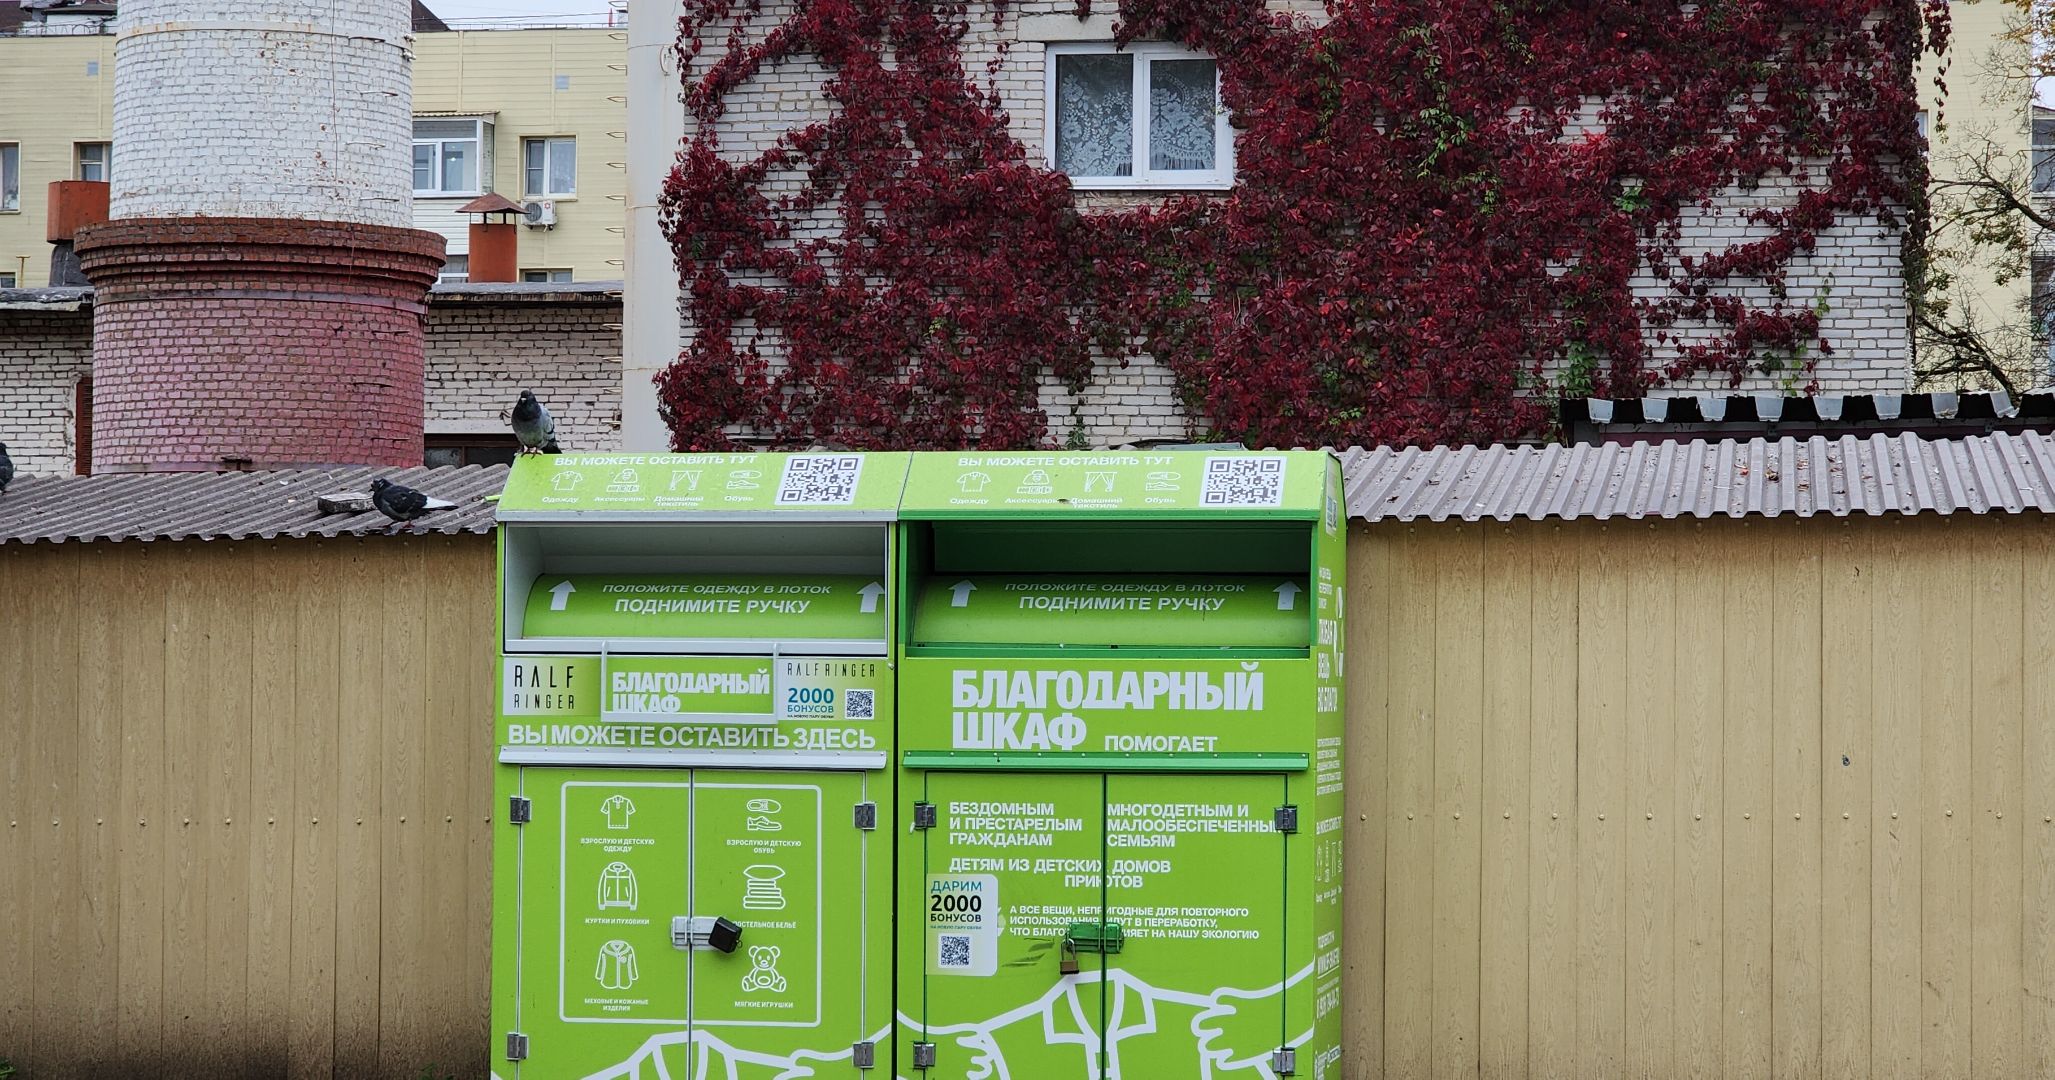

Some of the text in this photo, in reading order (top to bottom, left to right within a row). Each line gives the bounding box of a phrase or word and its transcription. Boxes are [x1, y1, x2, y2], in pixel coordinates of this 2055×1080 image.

[554, 455, 757, 467] ВЫ МОЖЕТЕ ОСТАВИТЬ ТУТ
[958, 456, 1173, 467] ВЫ МОЖЕТЕ ОСТАВИТЬ ТУТ
[542, 496, 579, 504] Одежду
[950, 497, 989, 505] Одежду
[1145, 496, 1176, 504] Обувь
[602, 583, 832, 594] ПОЛОЖИТЕ ОДЕЖДУ В ЛОТОК
[1004, 583, 1245, 593] ПОЛОЖИТЕ ОДЕЖДУ В ЛОТОК
[614, 599, 810, 615] ПОДНИМИТЕ РУЧКУ
[1019, 596, 1224, 613] ПОДНИМИТЕ РУЧКУ
[514, 665, 575, 688] RALF
[612, 668, 770, 694] БЛАГОДАРНЫЙ
[952, 662, 1264, 711] БЛАГОДАРНЫЙ
[514, 693, 575, 709] RINGER
[788, 688, 834, 704] 2000
[612, 694, 681, 713] ШКАФ
[788, 704, 834, 714] БОНУСОВ
[508, 725, 875, 749] ВЫ МОЖЕТЕ ОСТАВИТЬ ЗДЕСЬ
[952, 712, 1218, 752] ШКАФ ПОМОГАЕТ
[949, 802, 1054, 816] БЕЗДОМНЫМ
[1107, 804, 1249, 818] МНОГОДЕТНЫМ И
[949, 818, 1082, 831] И ПРЕСТАРЕЛЫМ
[1107, 818, 1277, 833] МАЛООБЕСПЕЧЕННЫ
[949, 833, 1052, 848] ГРАЖДАНАМ
[1107, 834, 1175, 848] СЕМЬЯМ
[949, 858, 1004, 872] ДЕТЯМ
[1008, 858, 1030, 871] ИЗ
[1112, 860, 1171, 875] ДОМОВ
[931, 880, 982, 894] ДАРИМ
[1065, 875, 1143, 888] ПРИЮТОВ
[931, 894, 982, 912] 2000
[930, 913, 982, 923] БОНУСОВ
[1010, 906, 1249, 917] А ВСЕ ВЕЩИ, НЕПРИГОДНЫЕ ДЛЯ ПОВТОРНОГО
[1135, 918, 1142, 927] В
[1144, 918, 1218, 928] ПЕРЕРАБОТКУ,
[1010, 927, 1030, 936] ЧТО
[1151, 929, 1166, 938] НА
[1168, 929, 1199, 939] НАШУ
[1201, 930, 1260, 939] ЭКОЛОГИЮ
